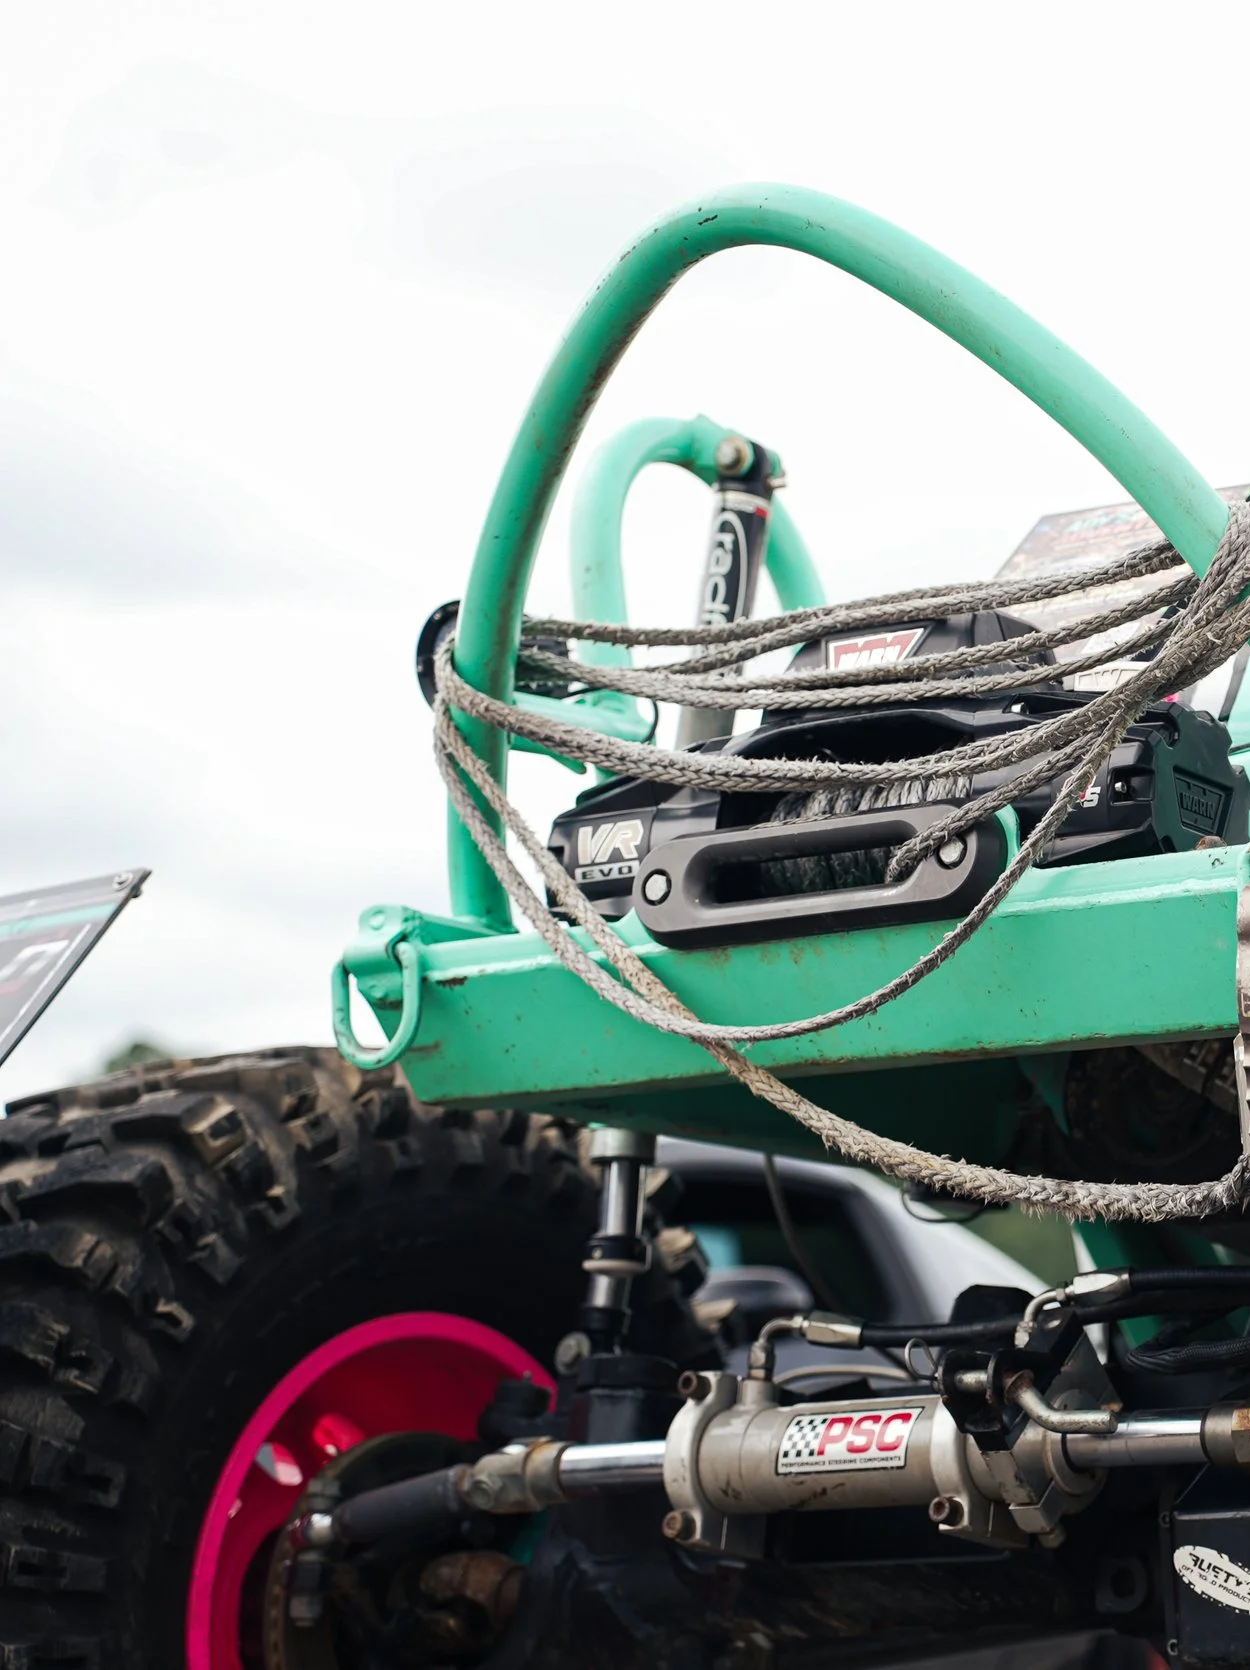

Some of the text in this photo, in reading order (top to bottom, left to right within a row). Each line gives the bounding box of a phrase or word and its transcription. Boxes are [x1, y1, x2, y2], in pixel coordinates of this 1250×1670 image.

[1179, 792, 1216, 820] WARN
[578, 819, 644, 865] VR
[582, 865, 633, 880] EVO
[817, 1413, 912, 1456] PSC
[859, 1456, 901, 1464] COMPONENTS
